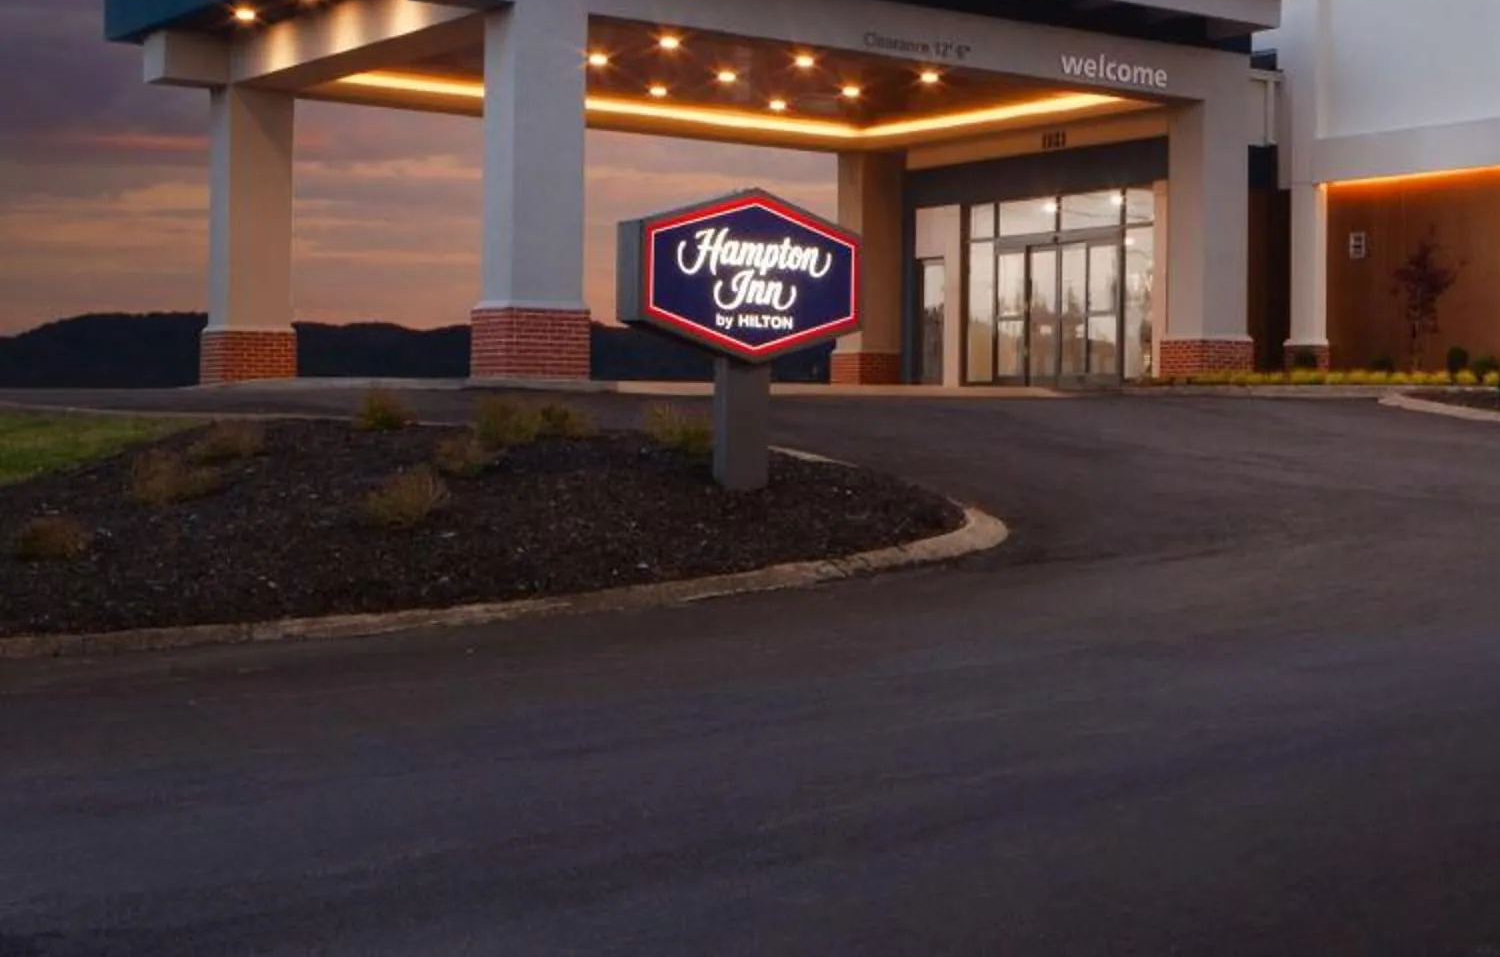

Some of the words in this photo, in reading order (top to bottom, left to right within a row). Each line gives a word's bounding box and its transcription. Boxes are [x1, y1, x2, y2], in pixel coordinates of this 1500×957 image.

[1061, 53, 1168, 88] welcome
[677, 227, 833, 278] Hampton
[713, 270, 797, 311] Inn
[715, 312, 734, 330] by
[738, 314, 794, 330] HILTON
